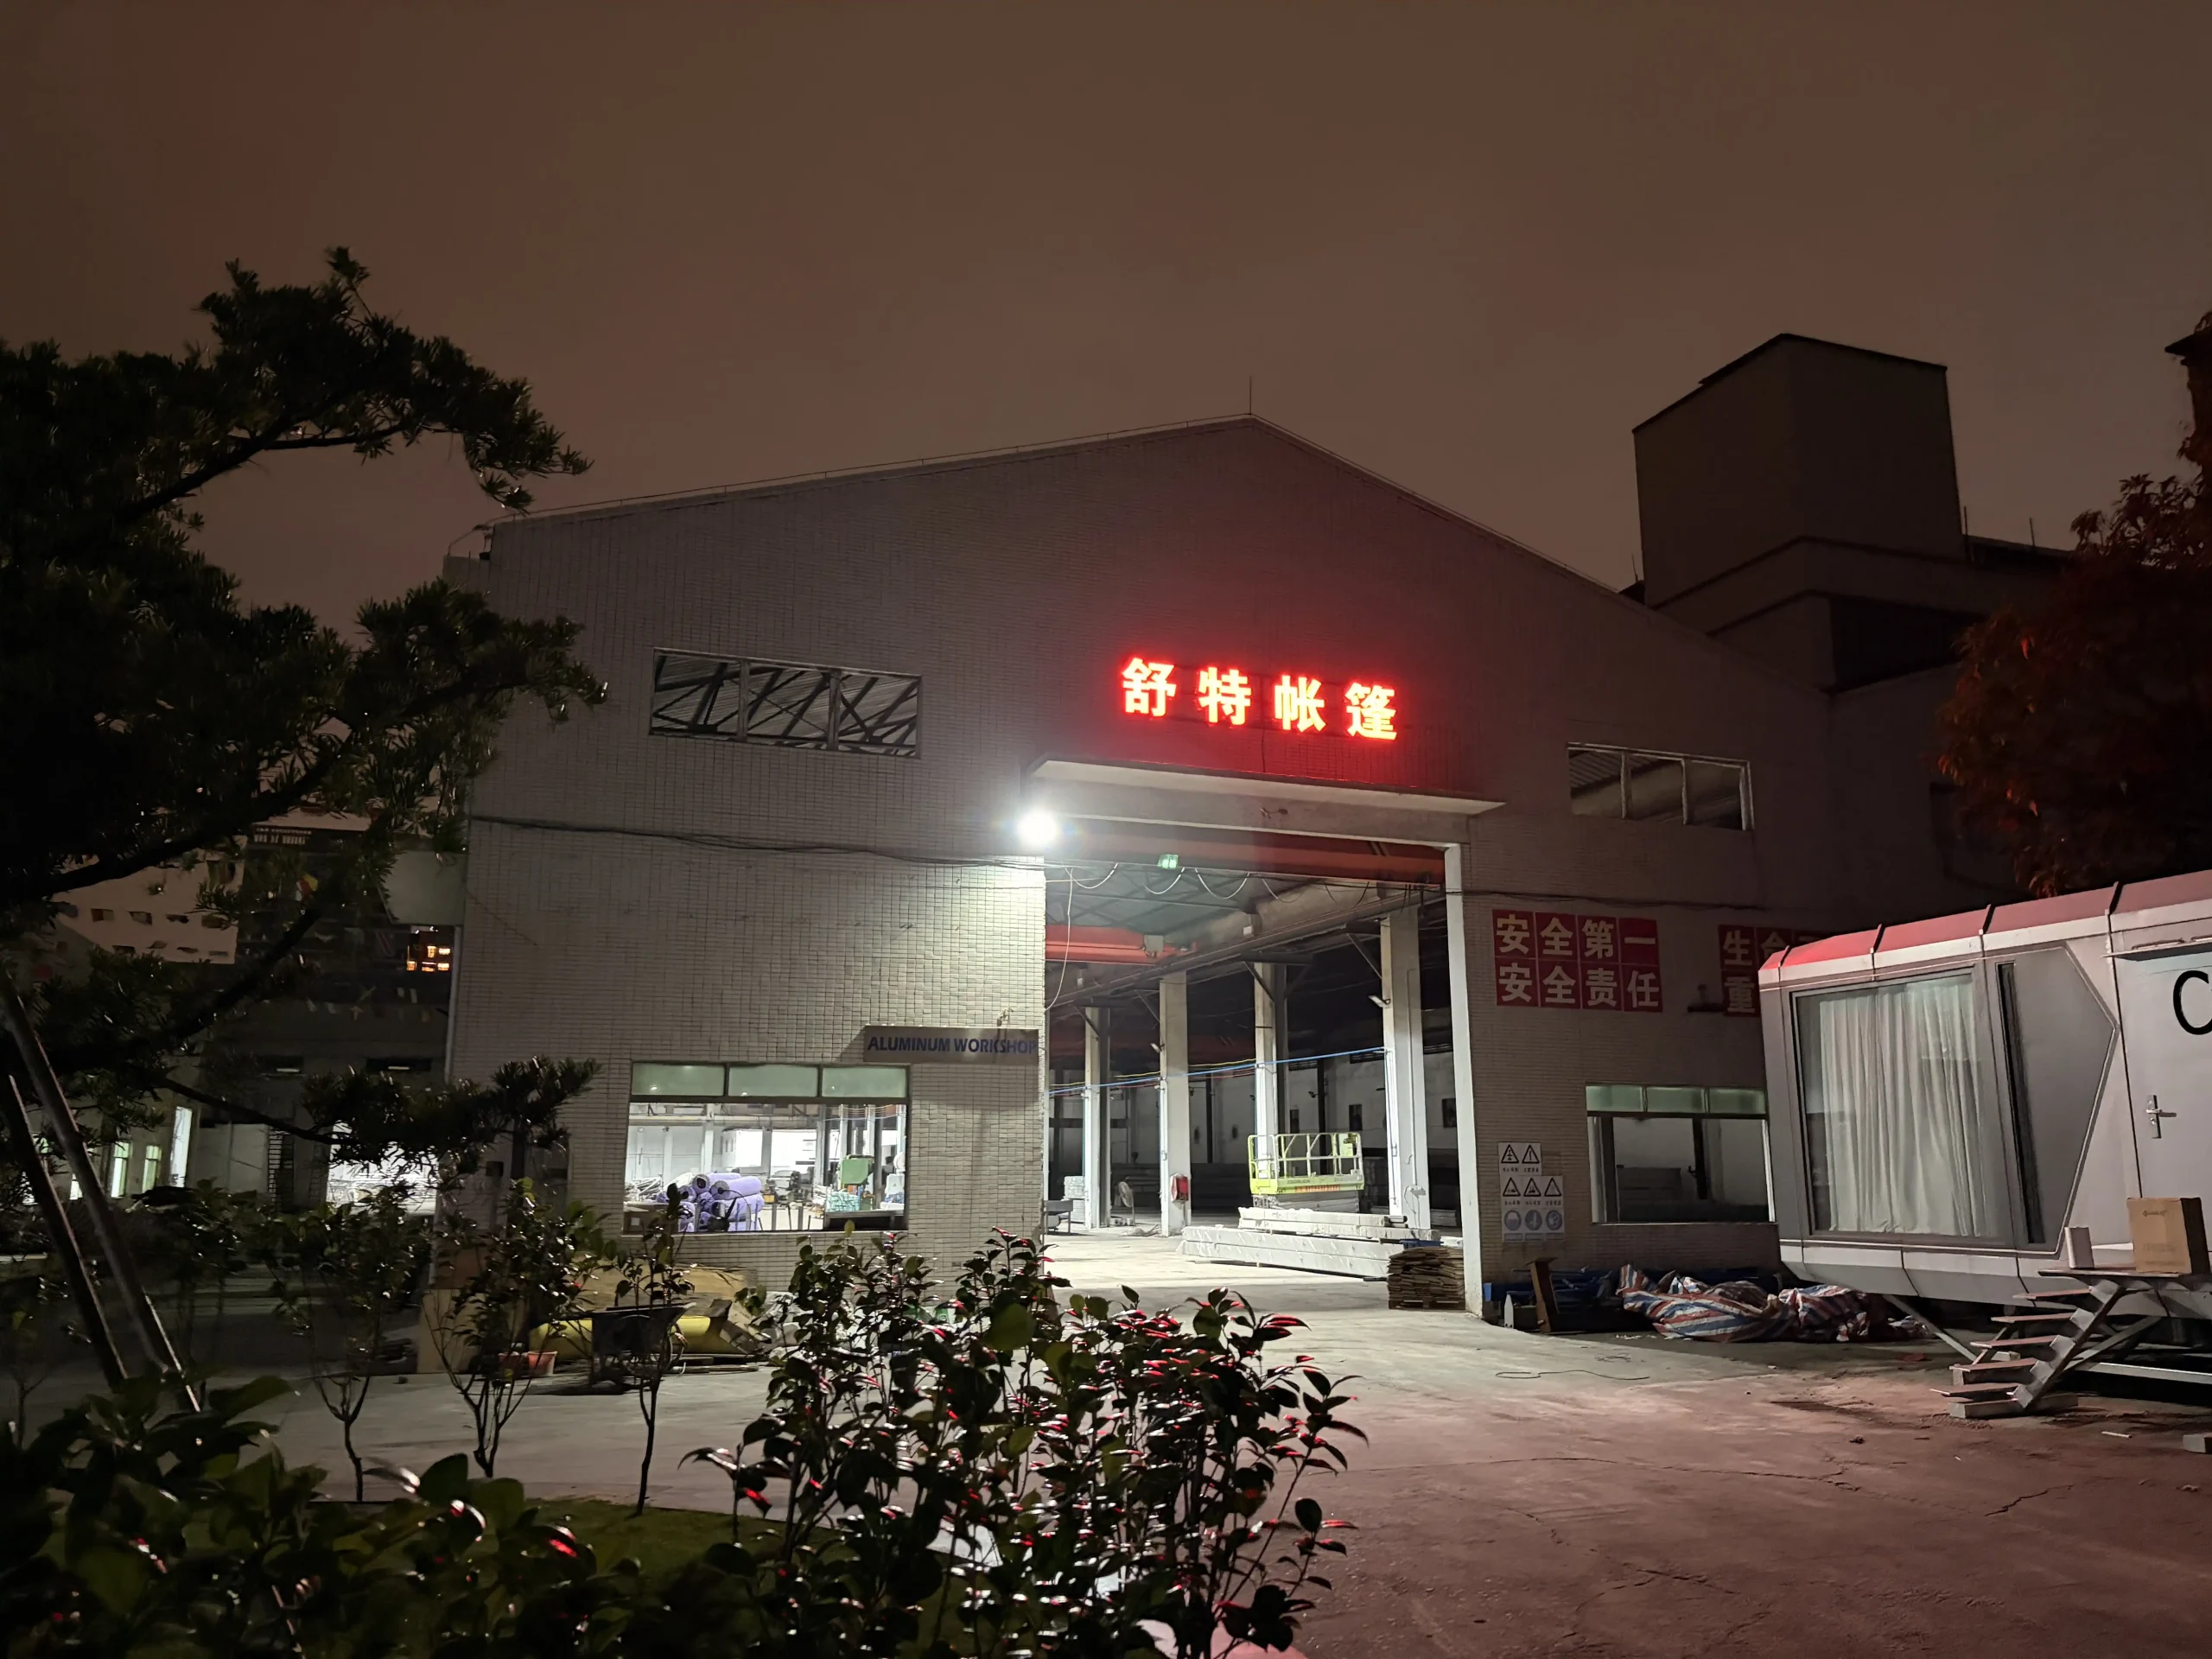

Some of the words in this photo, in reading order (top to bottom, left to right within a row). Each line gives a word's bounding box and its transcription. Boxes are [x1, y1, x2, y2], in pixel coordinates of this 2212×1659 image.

[1122, 657, 1397, 741] 舒特帐篷
[1496, 913, 1656, 959] 安全第一
[1498, 962, 1660, 1008] 安全责任
[867, 1036, 950, 1052] ALUMINUM
[953, 1038, 1037, 1054] WORKSHOP
